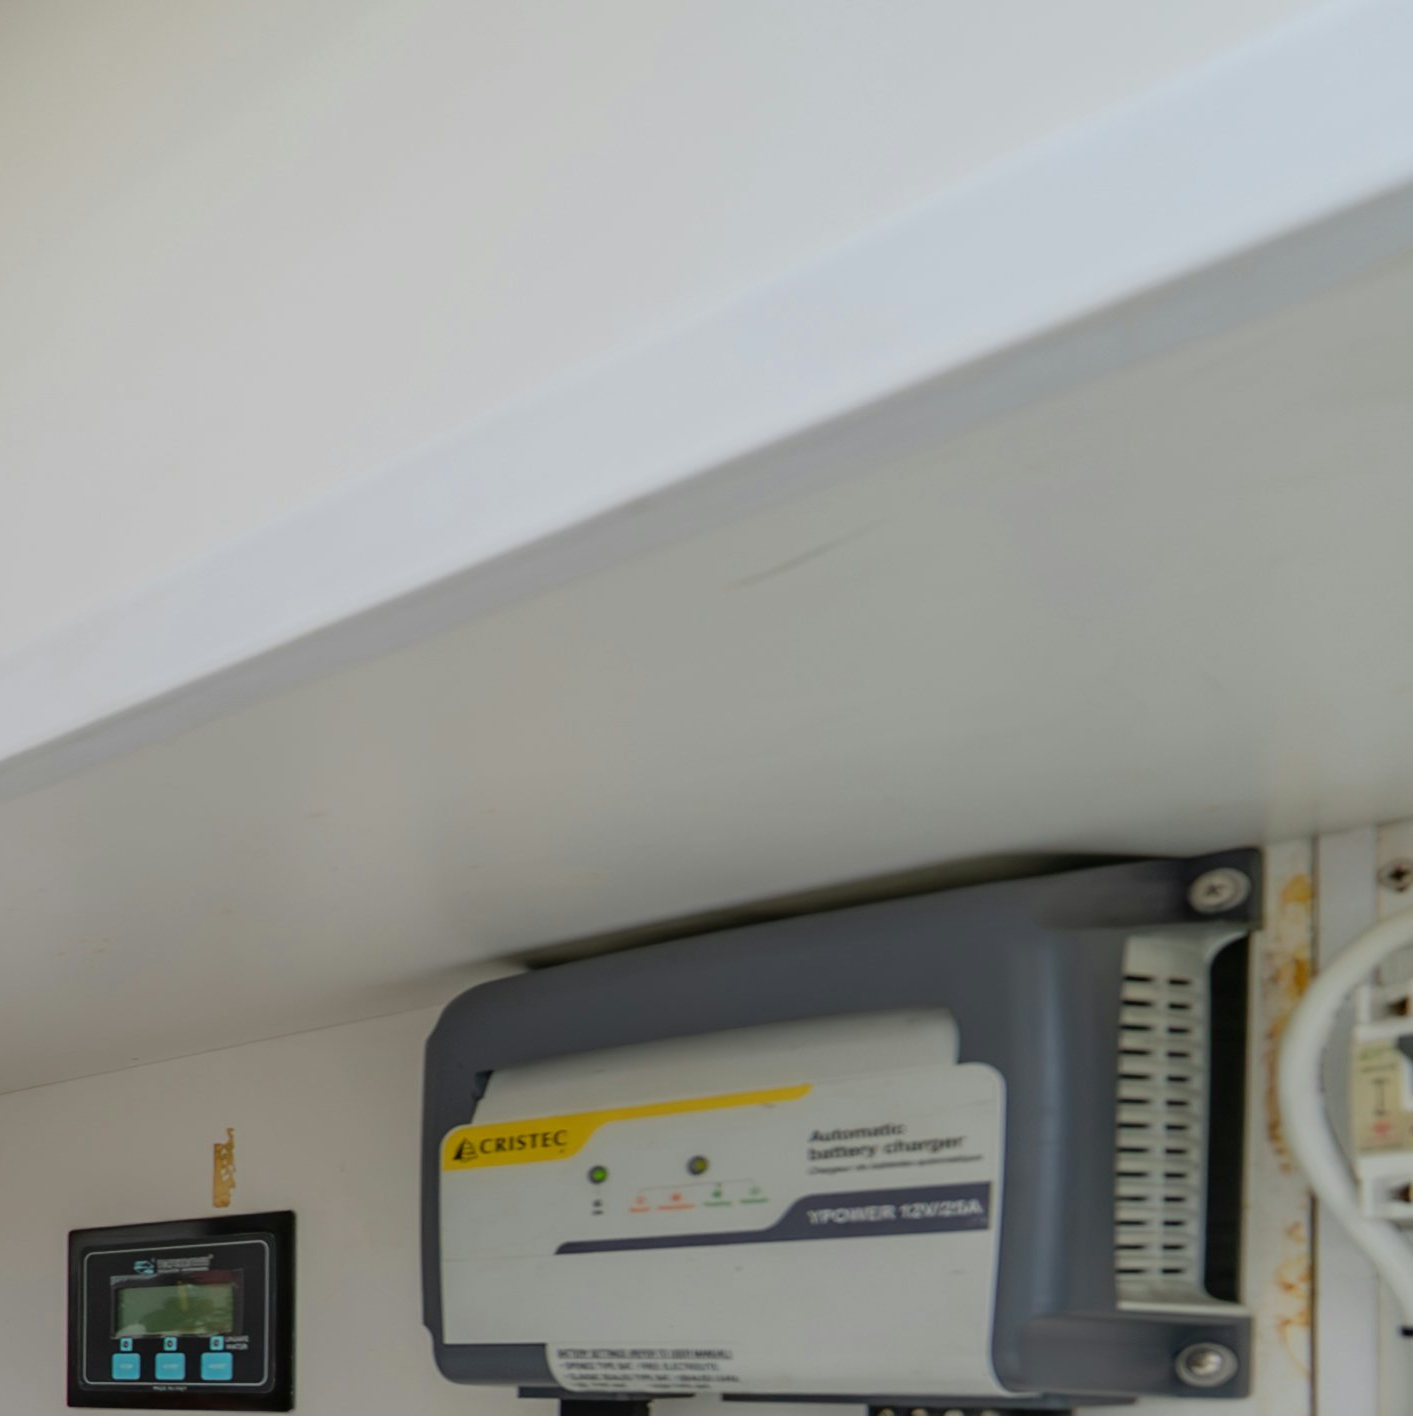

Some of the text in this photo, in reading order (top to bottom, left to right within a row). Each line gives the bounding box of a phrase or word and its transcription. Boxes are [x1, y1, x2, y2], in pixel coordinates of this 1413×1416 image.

[479, 1129, 568, 1155] CRISTEC
[809, 1122, 906, 1143] Automatic
[807, 1135, 966, 1162] battery charger
[805, 1204, 896, 1225] YPOWER
